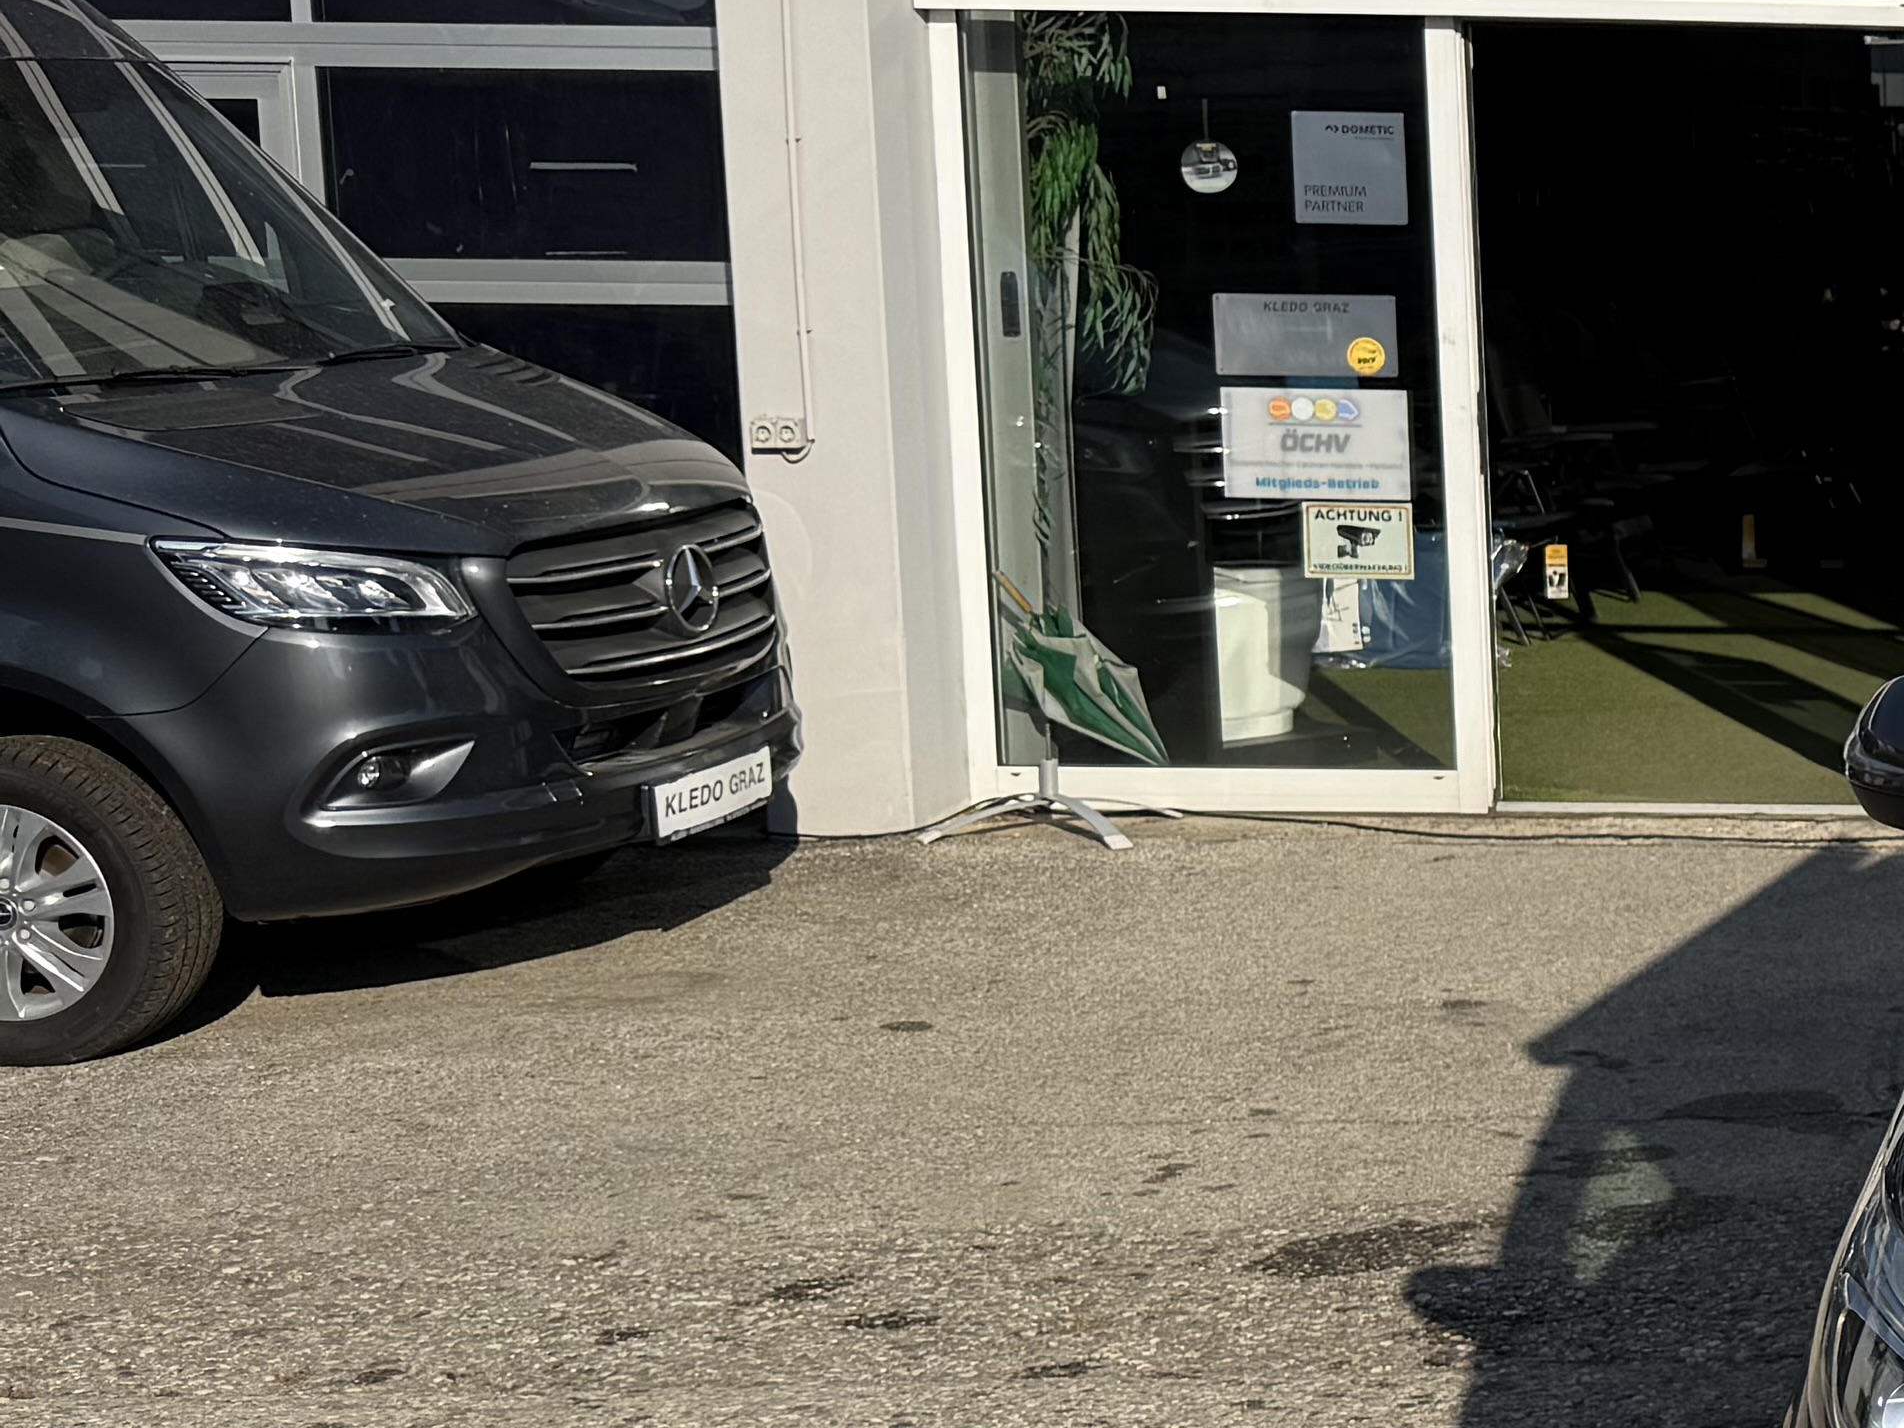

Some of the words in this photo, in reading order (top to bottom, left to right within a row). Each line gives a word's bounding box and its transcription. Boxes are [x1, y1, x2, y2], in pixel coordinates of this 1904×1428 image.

[1341, 124, 1395, 136] DOMETIC
[1304, 184, 1367, 198] PREMIUM
[1305, 199, 1365, 213] PARTNER
[1263, 300, 1309, 314] KLEDO
[1312, 301, 1351, 314] GRAZ
[1280, 428, 1352, 454] ÖCHV
[1255, 476, 1380, 492] Mitglieds-Betrieb
[1314, 509, 1393, 522] ACHTUNG
[664, 779, 723, 818] KLEDO
[729, 762, 766, 795] GRAZ
